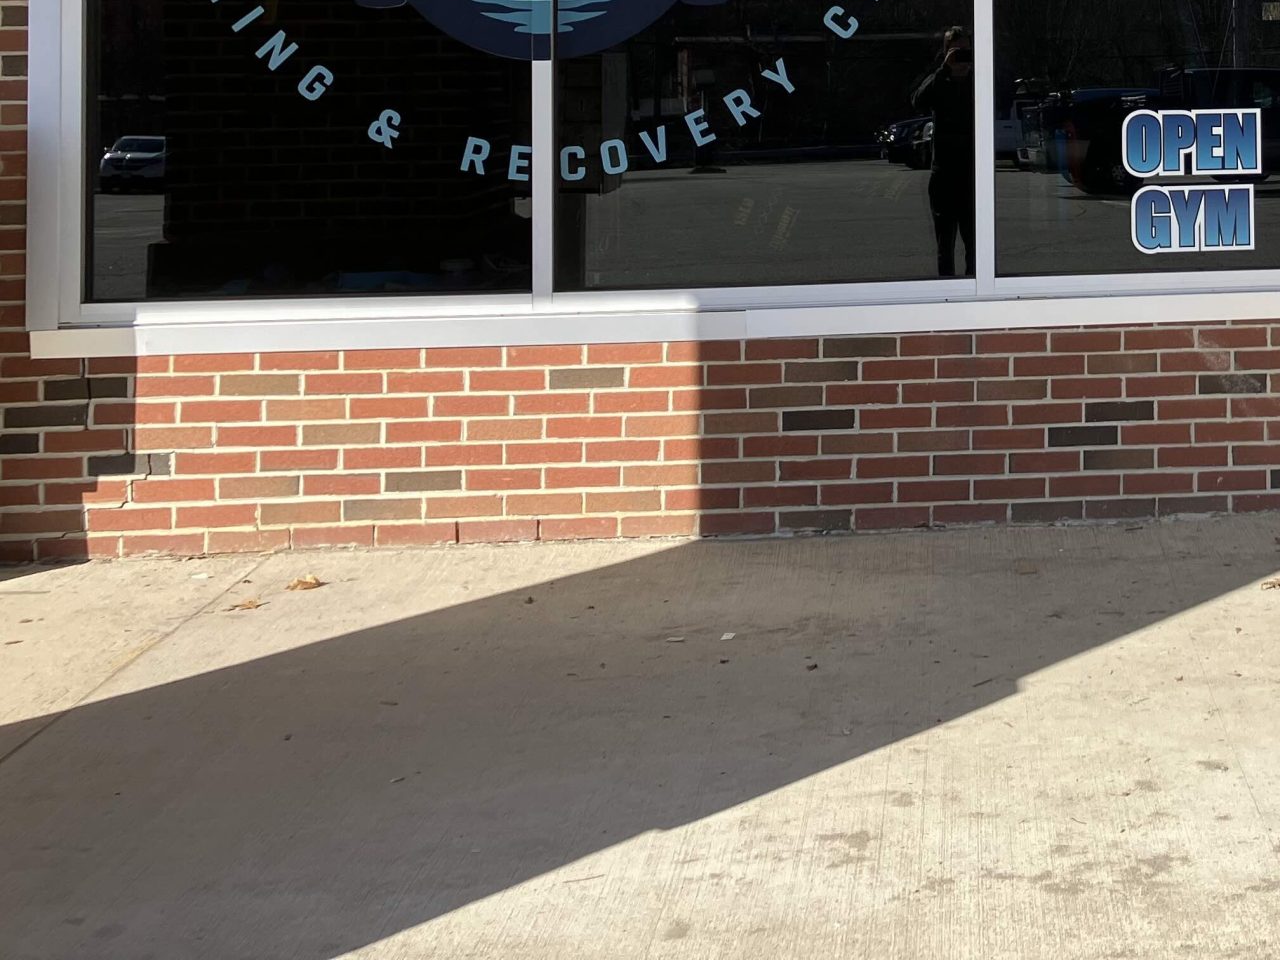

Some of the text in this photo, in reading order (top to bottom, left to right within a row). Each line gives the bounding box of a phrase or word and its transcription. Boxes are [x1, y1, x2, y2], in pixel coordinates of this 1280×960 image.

[367, 108, 402, 148] &
[459, 57, 797, 183] RECOVERY
[1122, 108, 1262, 177] OPEN
[1131, 184, 1256, 254] GYM
